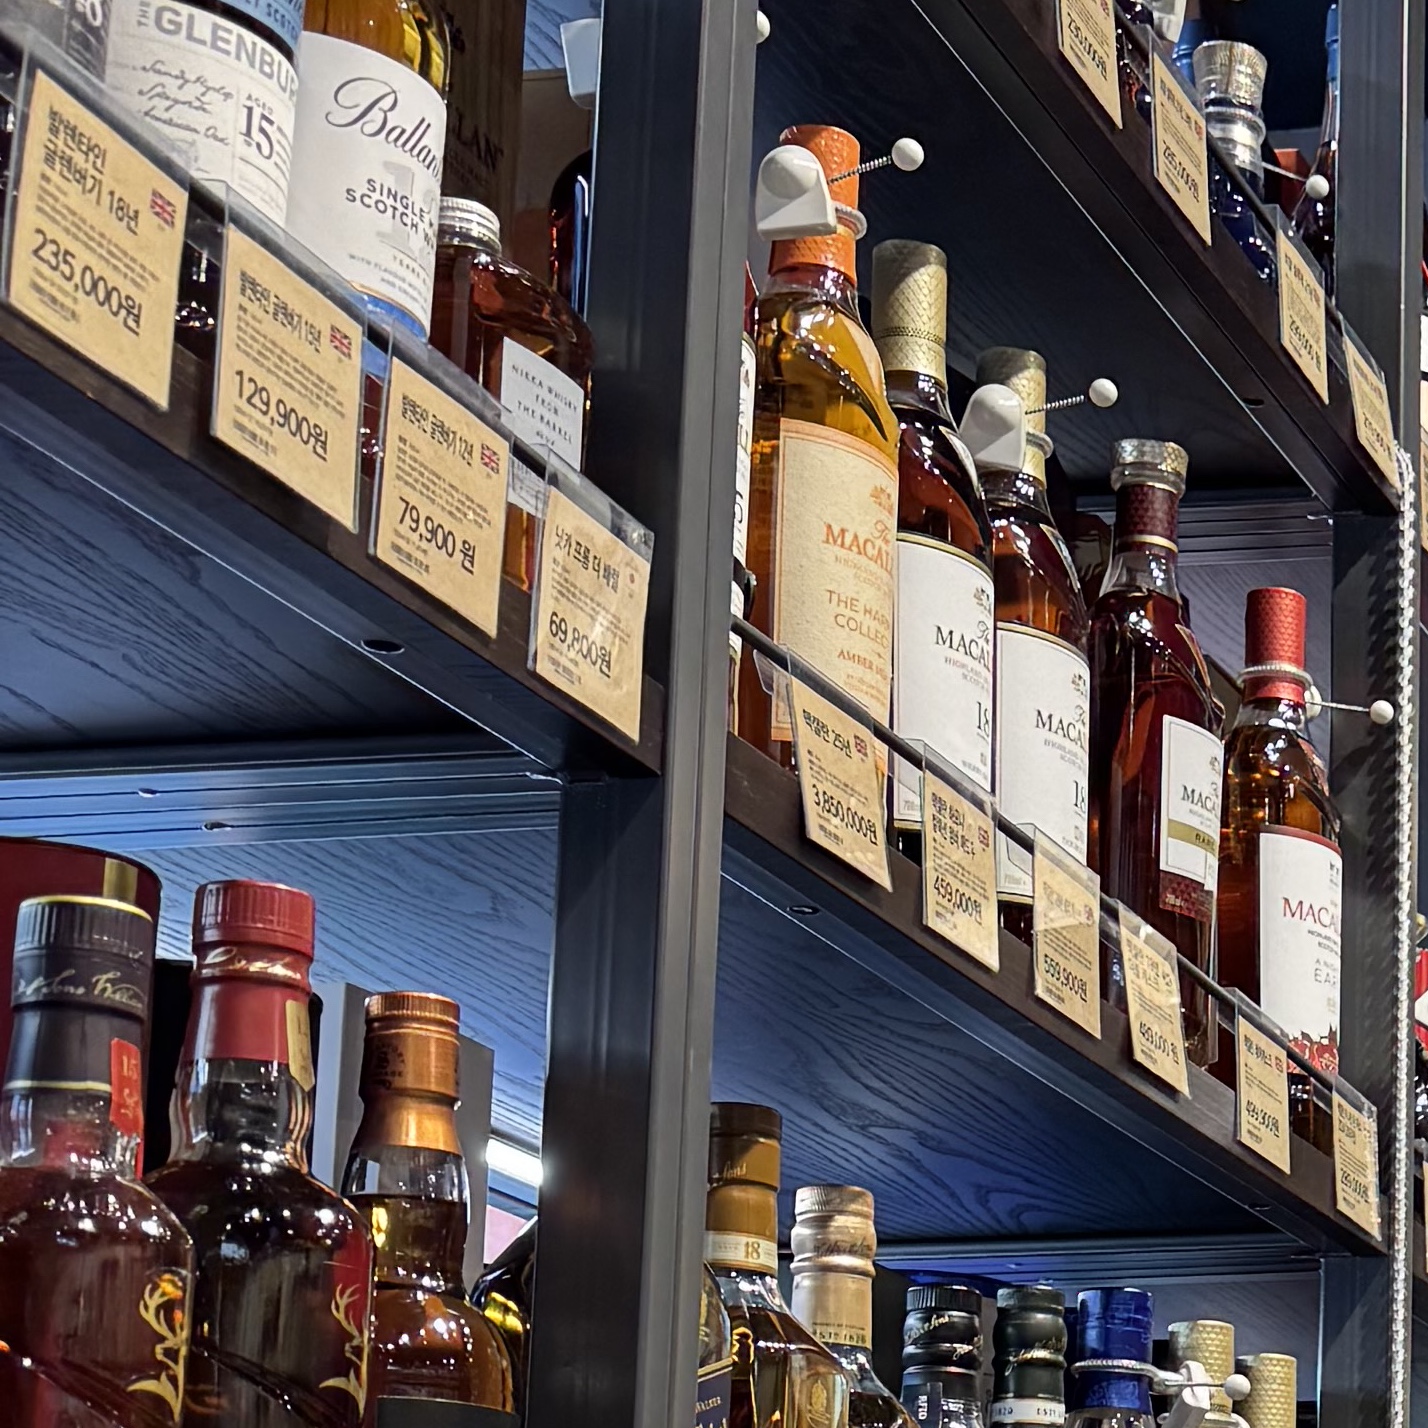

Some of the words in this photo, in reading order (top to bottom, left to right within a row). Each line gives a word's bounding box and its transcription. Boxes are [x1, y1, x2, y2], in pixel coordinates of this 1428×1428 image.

[239, 103, 276, 160] 15
[108, 189, 140, 237] 18년
[345, 187, 419, 236] SCOTCH
[366, 177, 425, 222] SINGLE
[31, 227, 142, 338] 235,000원
[233, 368, 329, 464] 129,900원
[397, 496, 457, 561] 79,900
[460, 540, 477, 577] 원
[825, 589, 860, 614] THE
[548, 610, 613, 680] 69,800원
